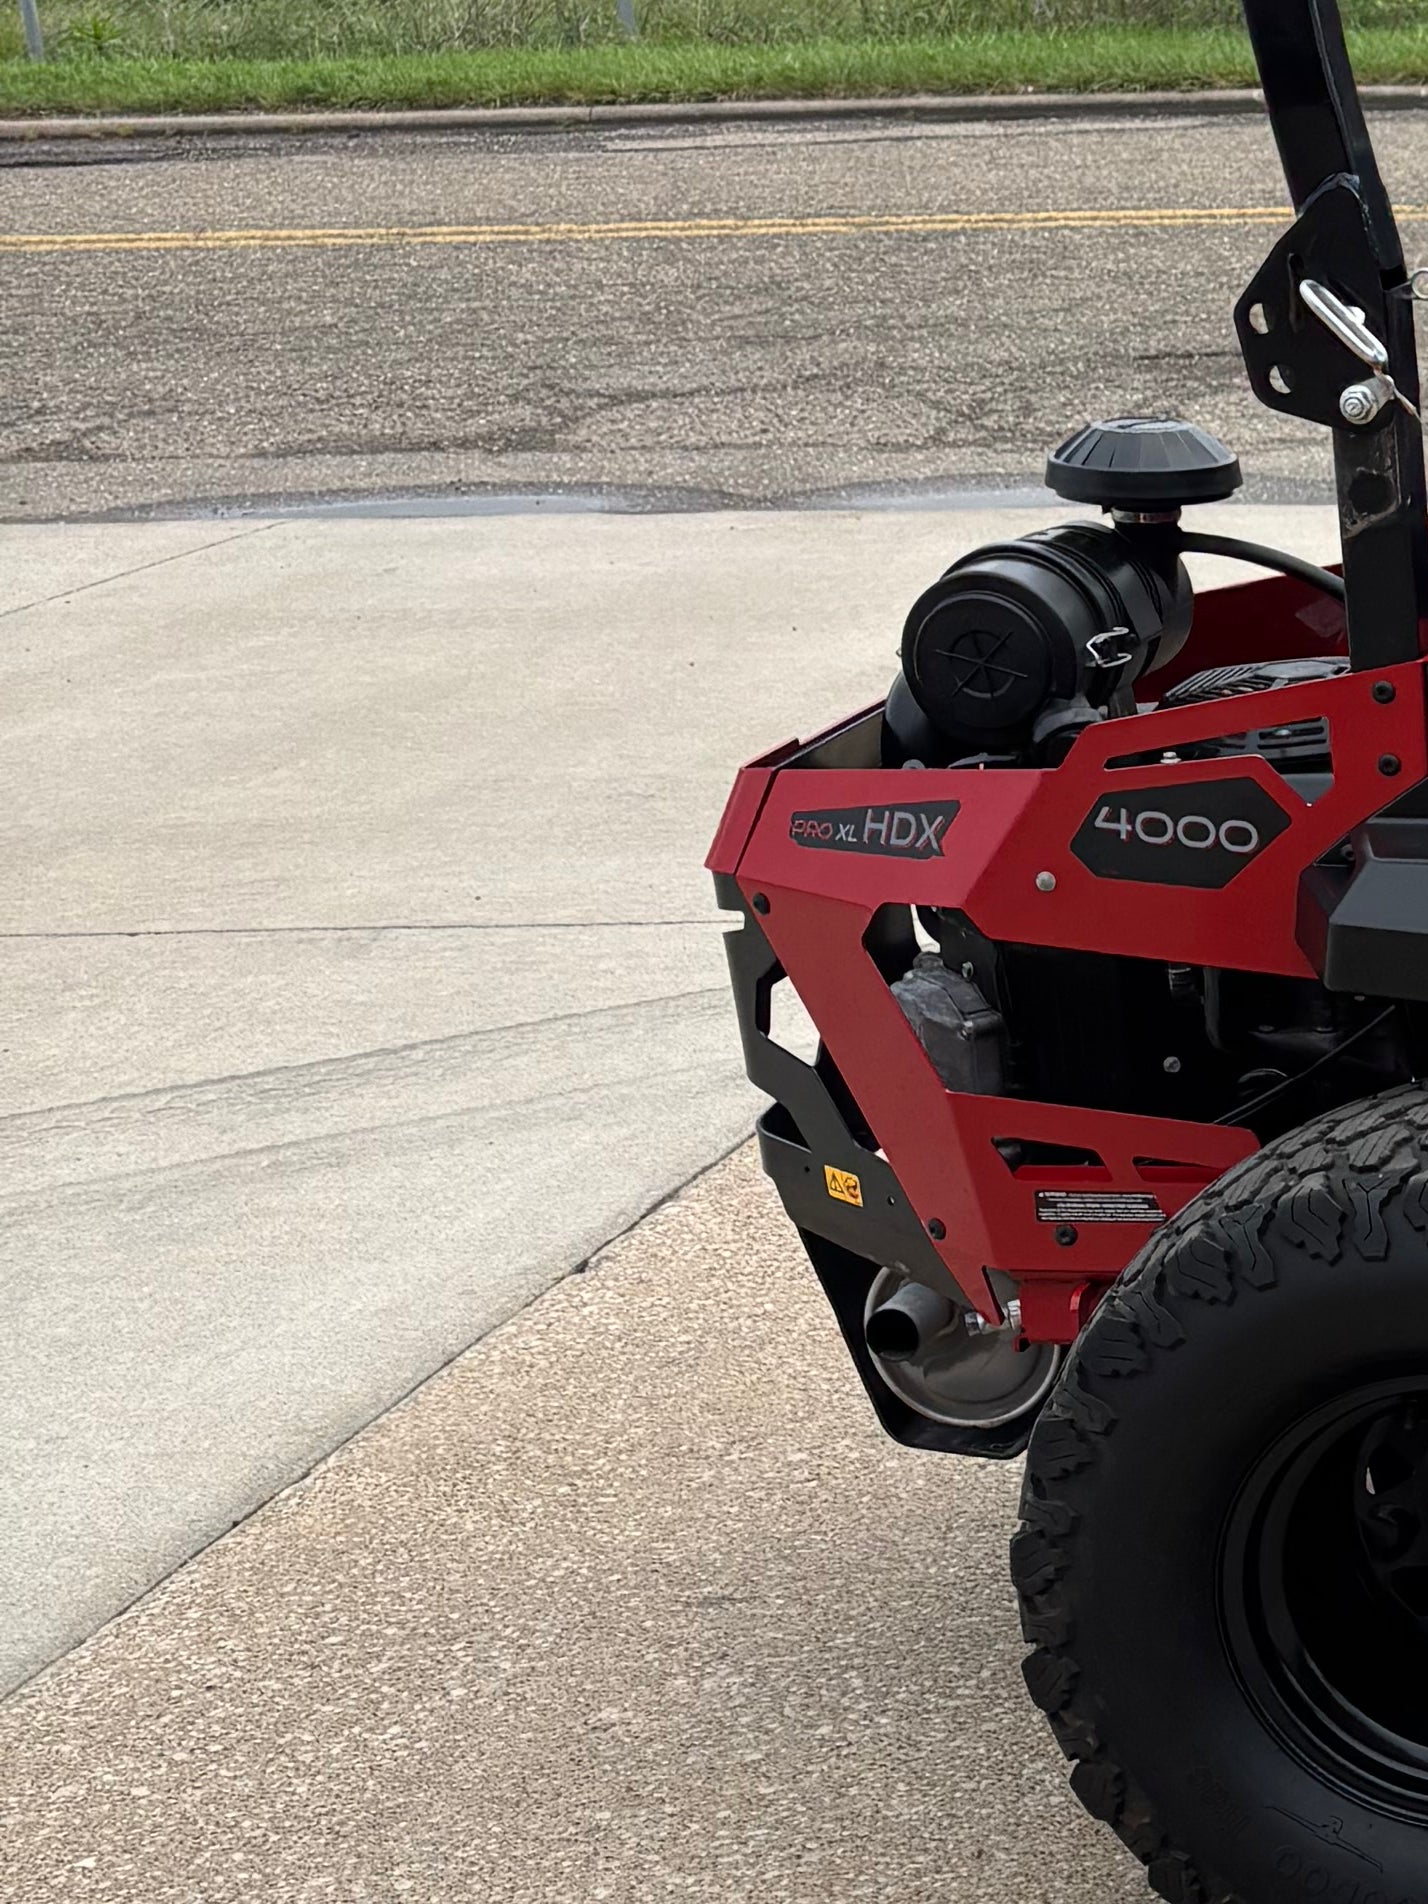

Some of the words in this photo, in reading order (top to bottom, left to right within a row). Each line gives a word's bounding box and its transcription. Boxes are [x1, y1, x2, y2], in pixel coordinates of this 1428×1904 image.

[791, 819, 834, 840] PRO
[835, 823, 858, 843] XL
[862, 808, 946, 851] HDX
[1094, 806, 1260, 854] 4000
